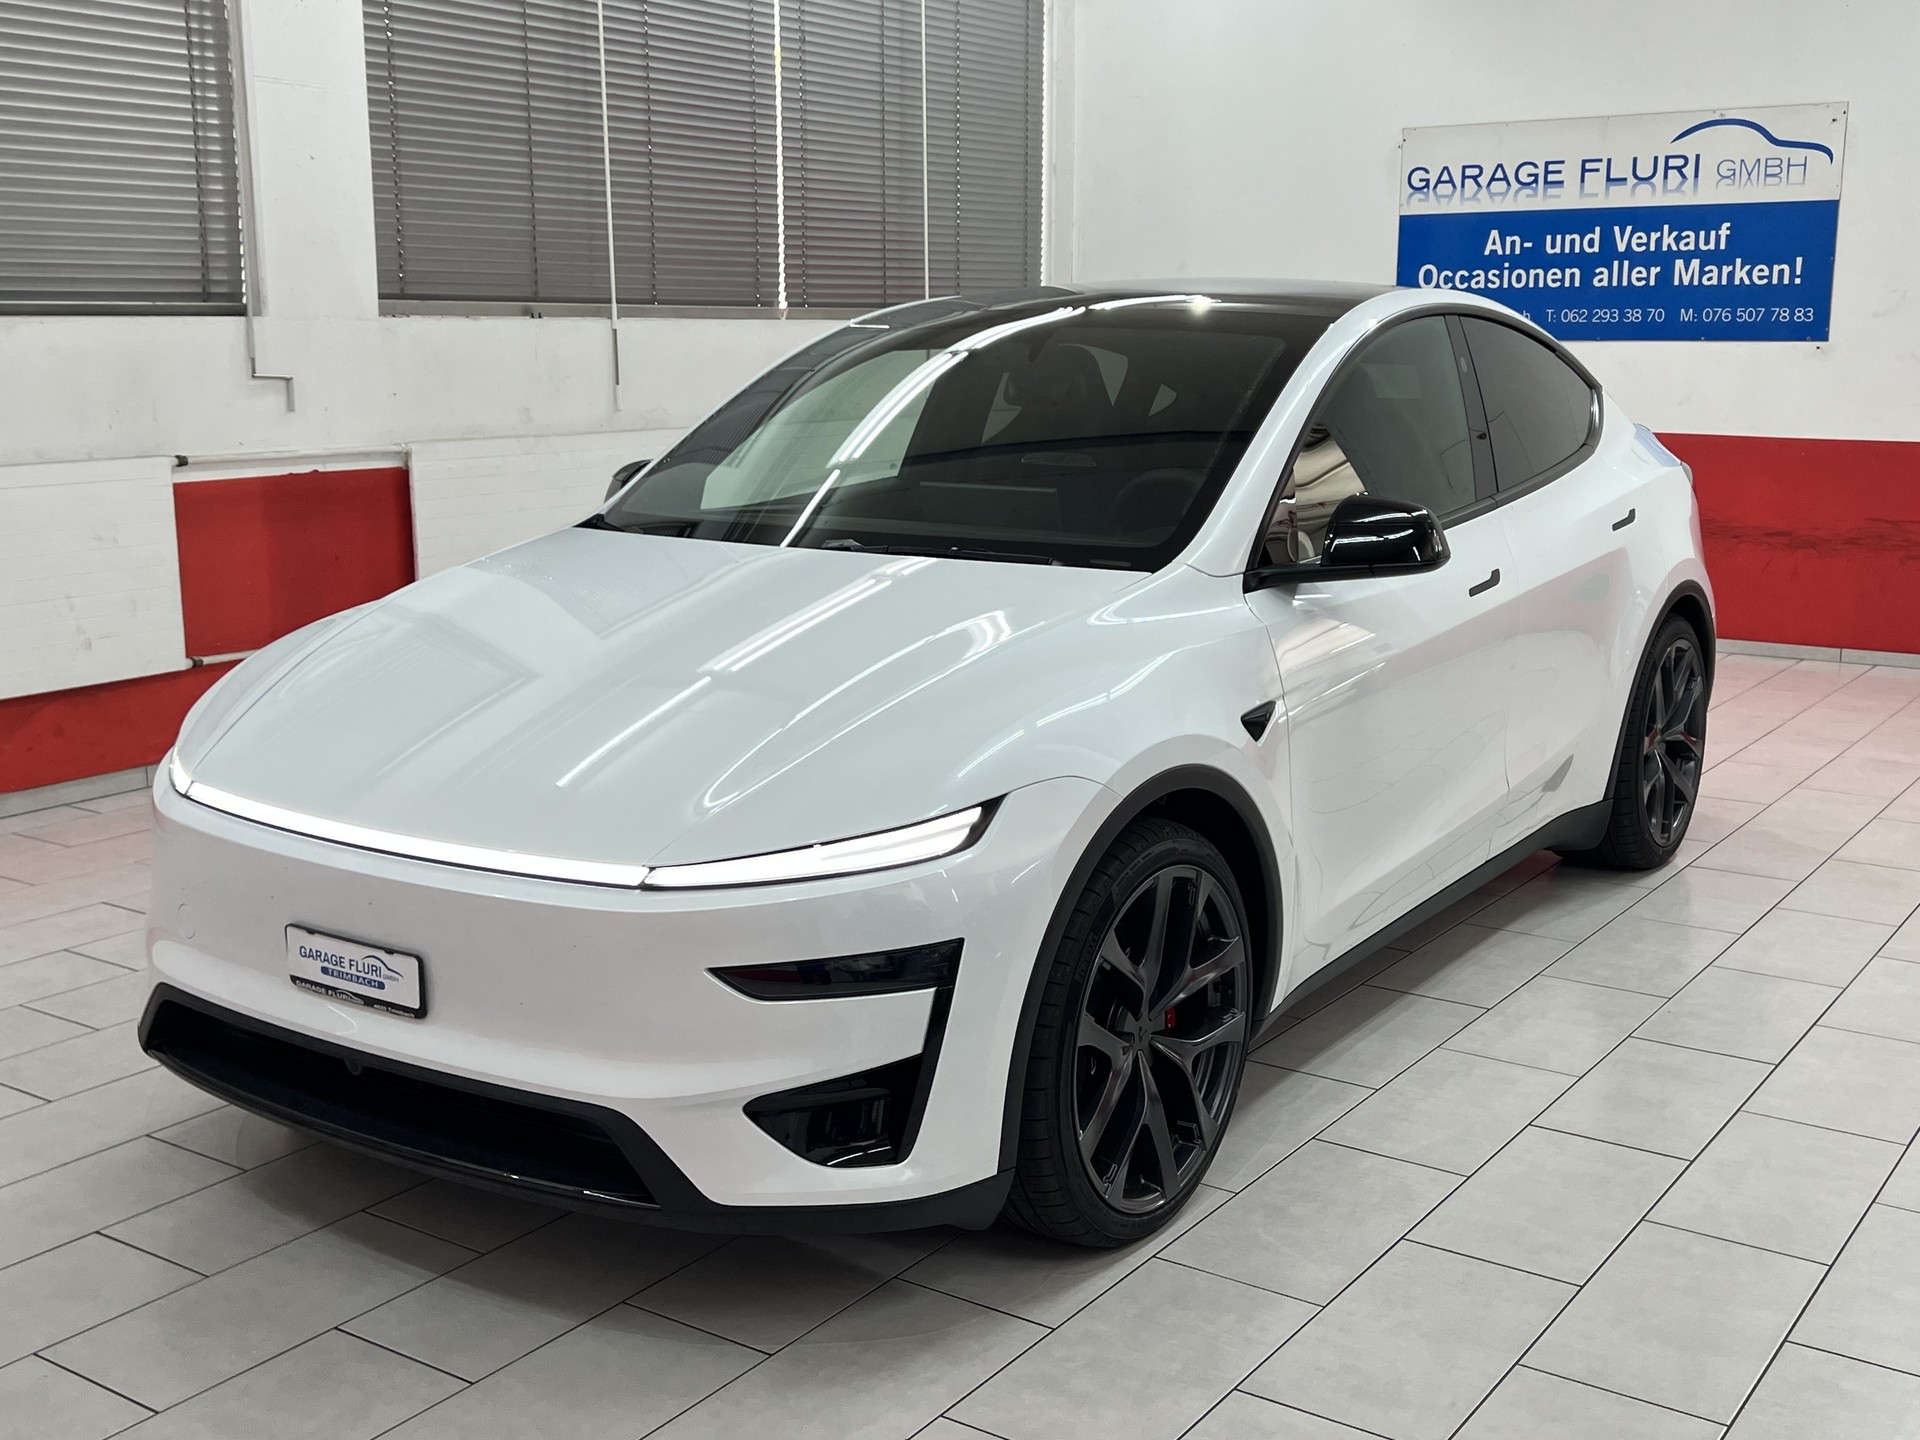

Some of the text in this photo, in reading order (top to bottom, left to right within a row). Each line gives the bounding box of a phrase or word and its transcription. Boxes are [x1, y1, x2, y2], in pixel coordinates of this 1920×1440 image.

[1407, 153, 1808, 191] GARAGE FLURI GMBH
[1484, 222, 1731, 256] An- und Verkauf
[1418, 256, 1803, 289] Occasionen aller Marken!
[1546, 309, 1557, 323] T:
[1560, 309, 1588, 323] 062
[1592, 309, 1619, 323] 293
[1623, 308, 1642, 323] 38
[1647, 308, 1665, 323] 70
[1680, 308, 1698, 322] M:
[1702, 308, 1732, 322] 076
[1736, 308, 1765, 322] 507
[1770, 308, 1790, 322] 78
[1793, 307, 1814, 322] 83
[299, 945, 346, 969] GARAGE
[349, 959, 382, 978] FLURI
[328, 968, 379, 988] TRIMBACH
[295, 980, 351, 1001] GARAGE FLURI
